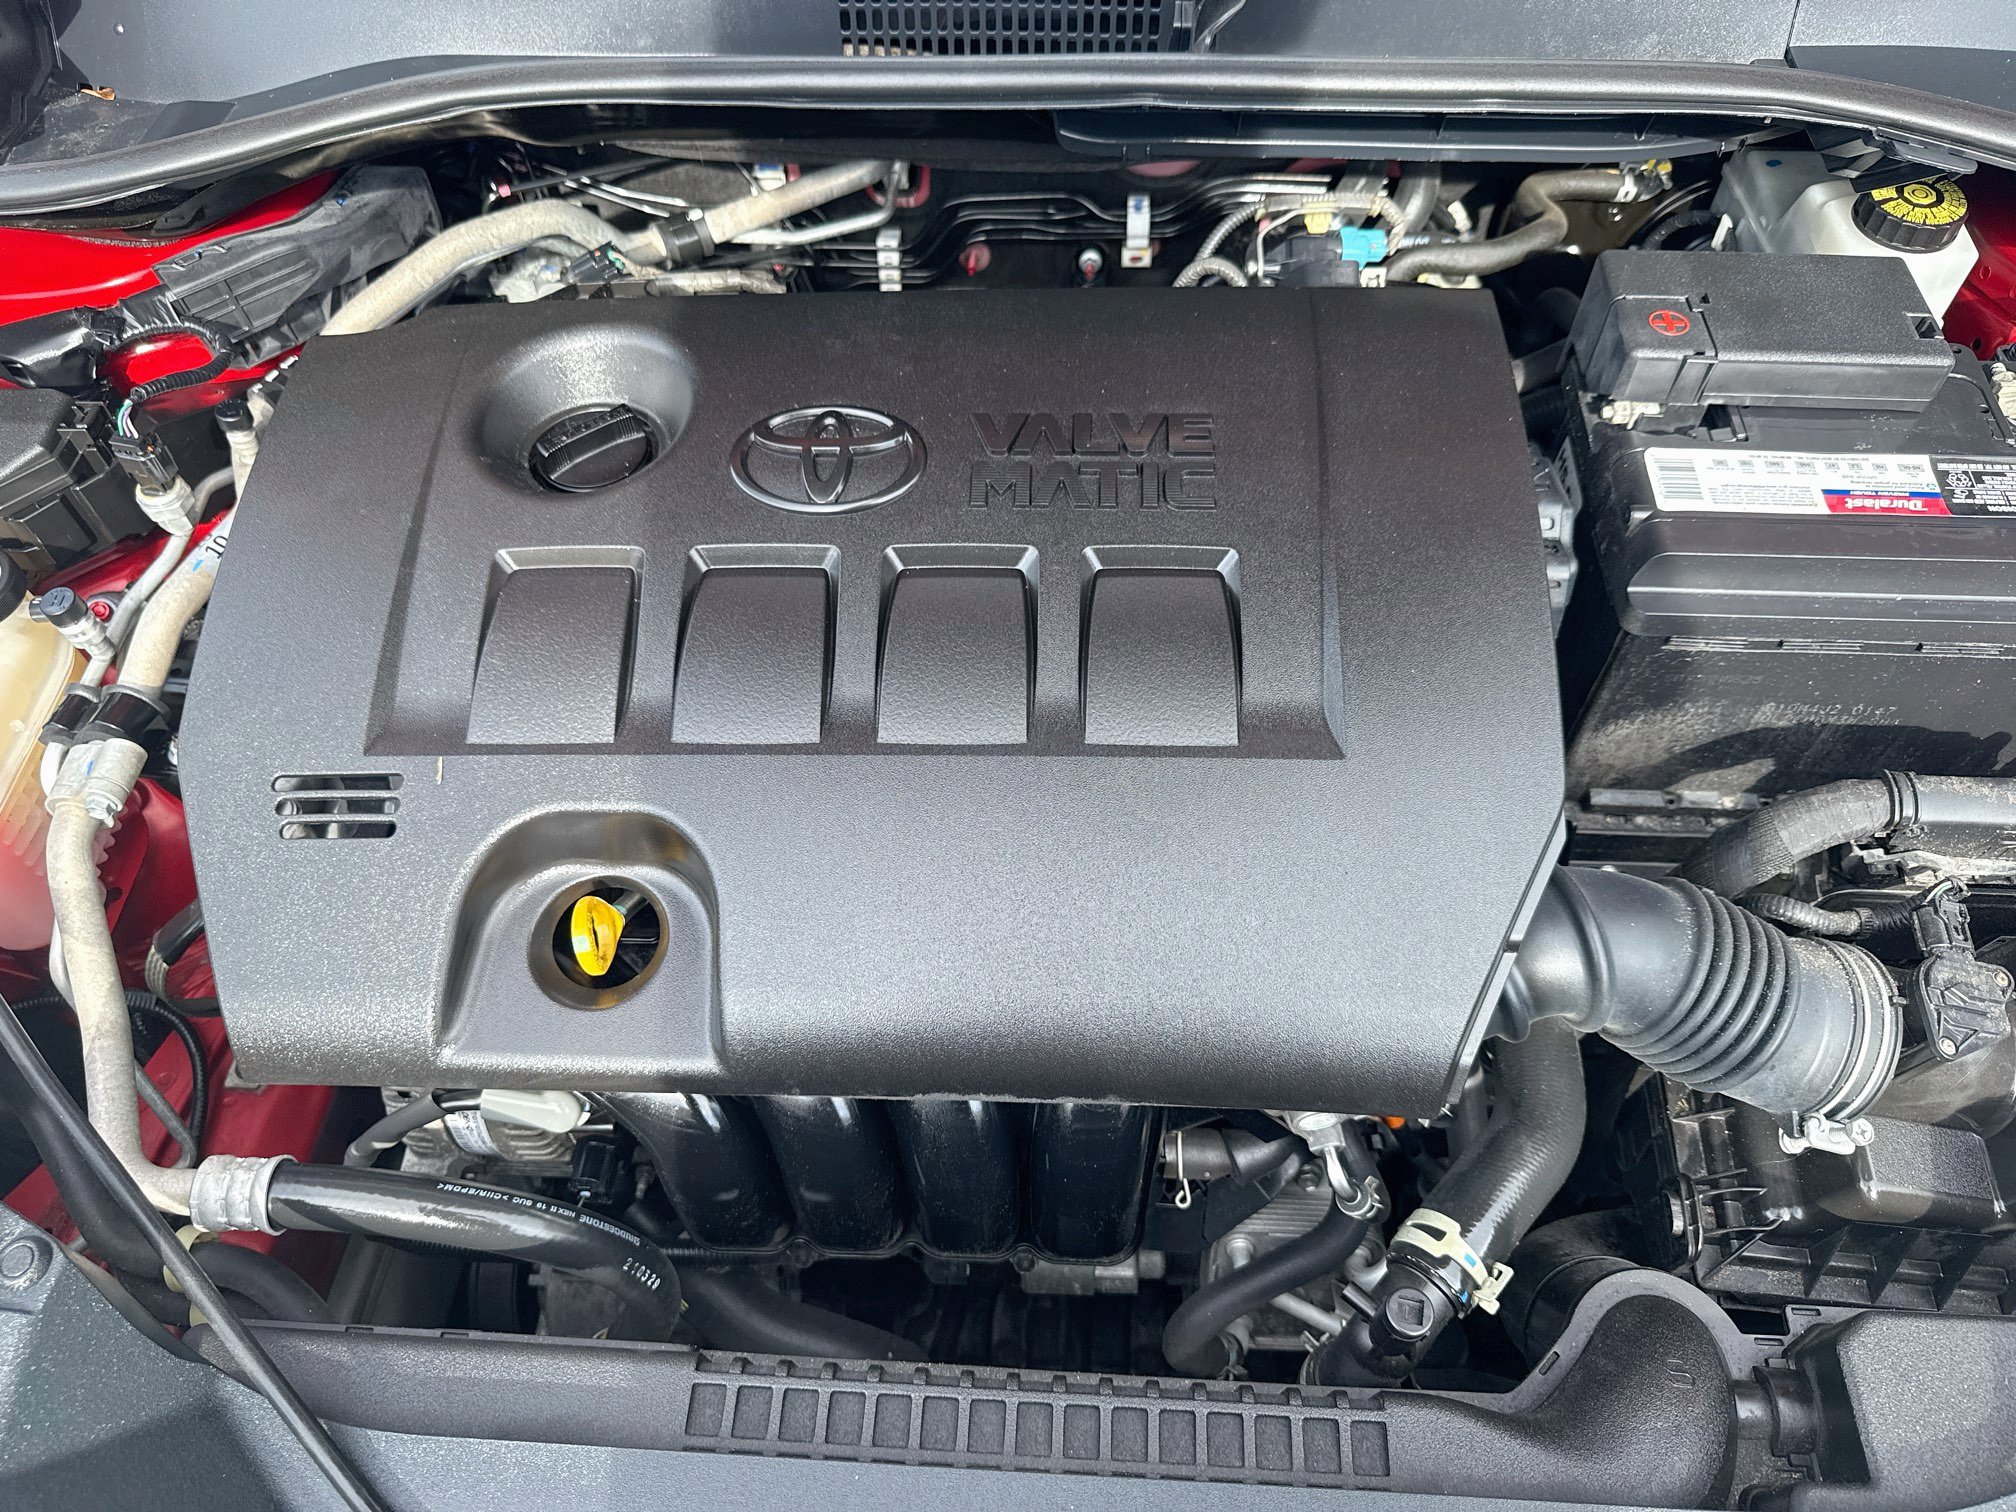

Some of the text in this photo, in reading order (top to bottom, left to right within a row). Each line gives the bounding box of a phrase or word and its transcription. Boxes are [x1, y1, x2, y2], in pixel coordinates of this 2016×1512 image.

[970, 413, 1215, 457] VALVE
[969, 460, 1217, 511] MATIC
[1845, 498, 1928, 511] Duralast
[512, 1196, 533, 1206] SUC
[536, 1202, 547, 1210] 19
[579, 1214, 640, 1246] BRIDGESTONE
